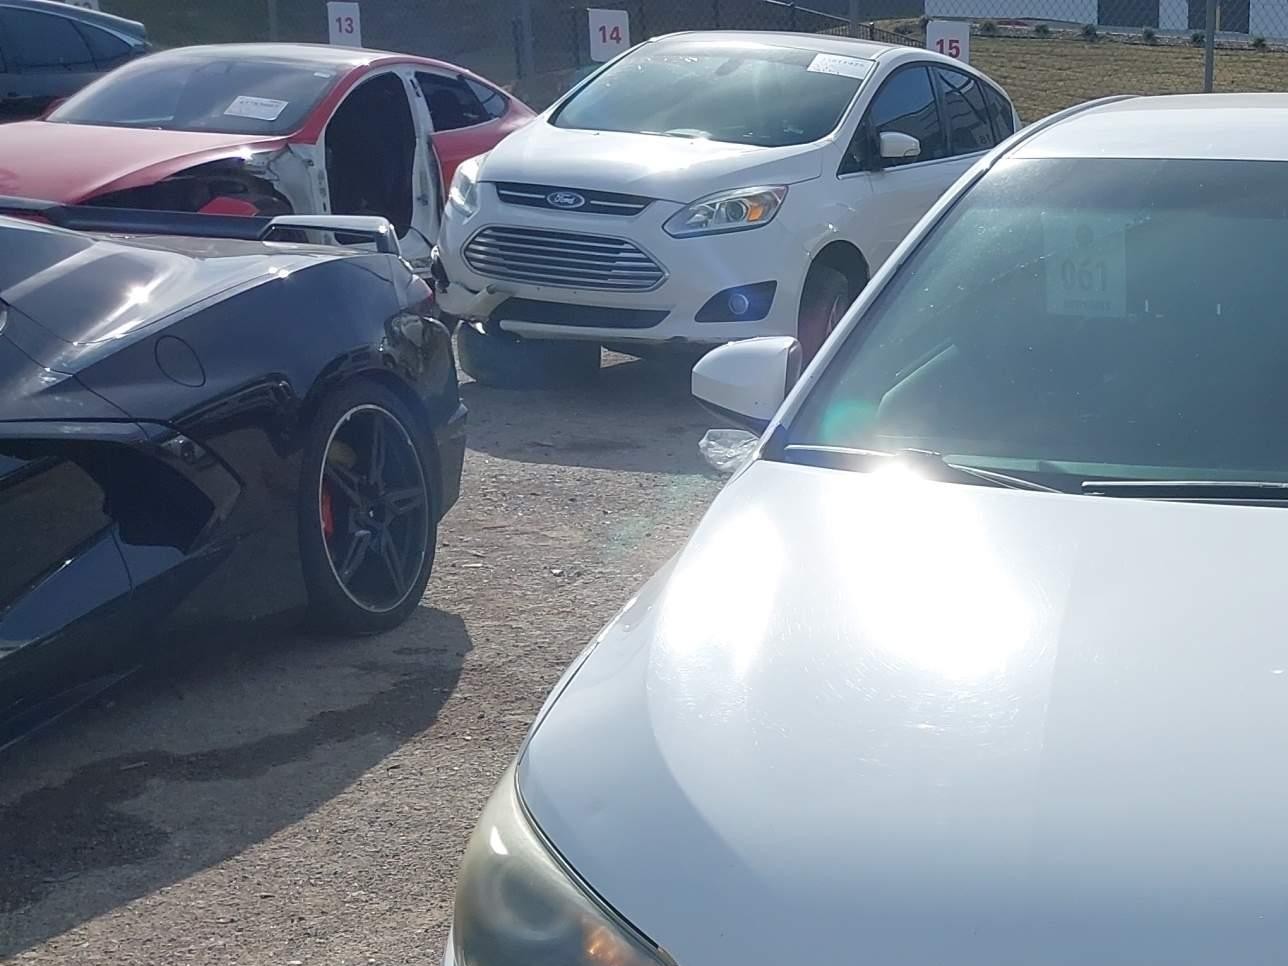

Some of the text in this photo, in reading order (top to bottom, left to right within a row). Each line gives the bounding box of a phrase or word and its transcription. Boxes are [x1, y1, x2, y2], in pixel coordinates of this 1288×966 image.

[335, 16, 354, 34] 13
[598, 25, 622, 44] 14
[935, 39, 961, 59] 15
